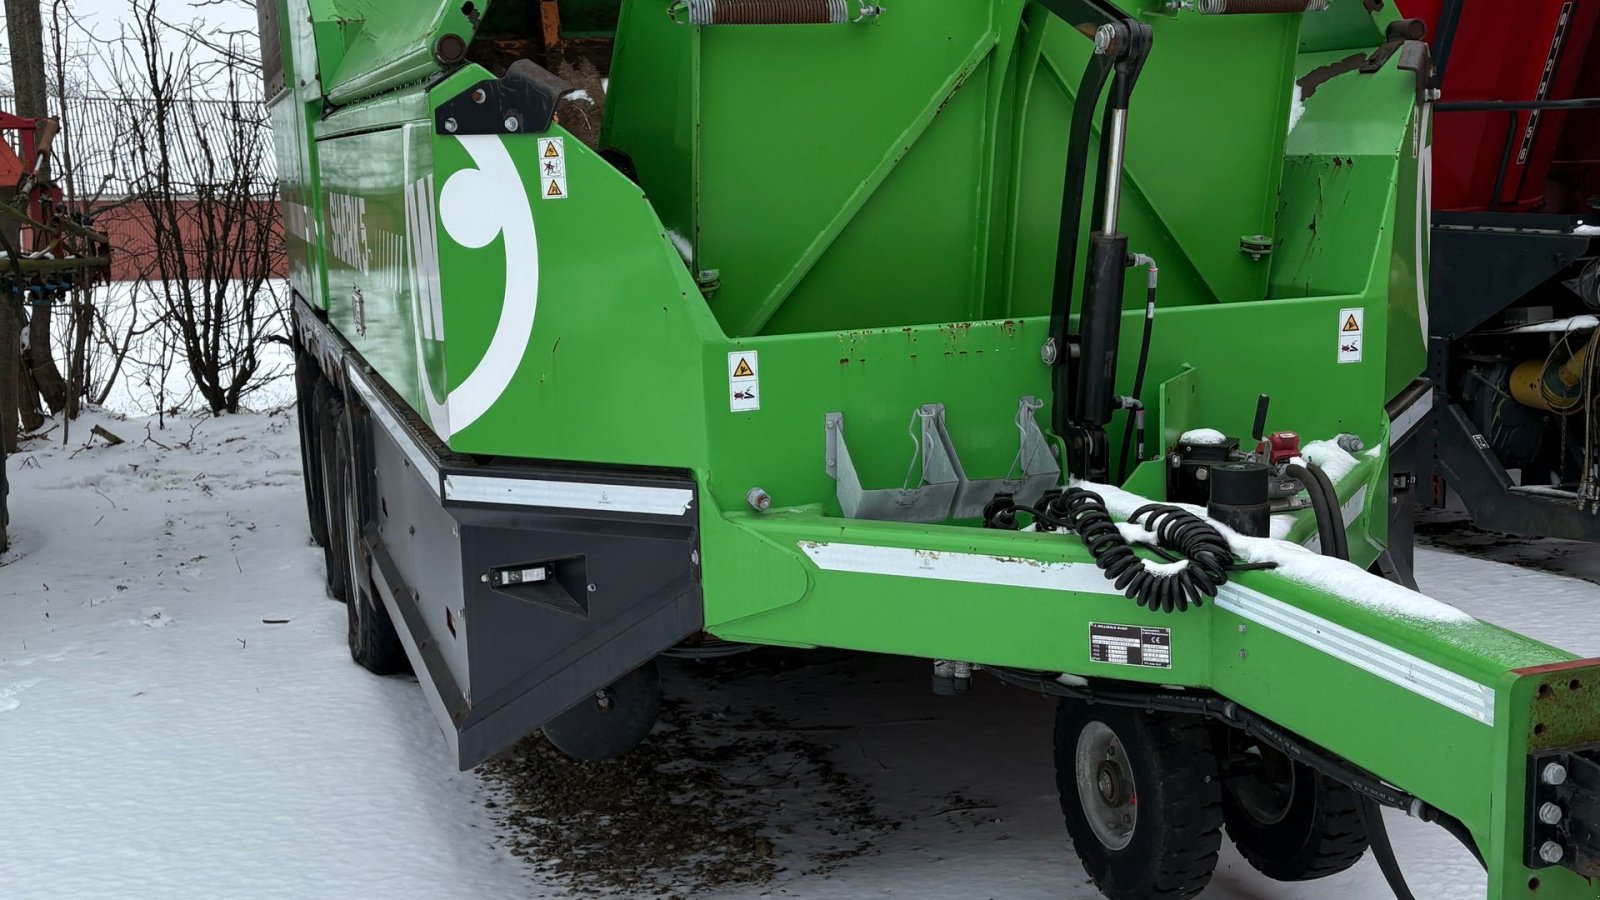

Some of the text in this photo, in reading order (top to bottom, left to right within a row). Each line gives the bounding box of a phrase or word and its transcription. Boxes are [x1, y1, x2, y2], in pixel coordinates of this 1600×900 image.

[1559, 12, 1567, 26] 0
[1553, 36, 1560, 49] 1
[1545, 59, 1554, 71] 2
[1539, 82, 1546, 94] 3
[1526, 126, 1533, 138] 5
[1519, 148, 1527, 160] 6
[329, 191, 362, 272] SHARK
[358, 197, 369, 276] 5
